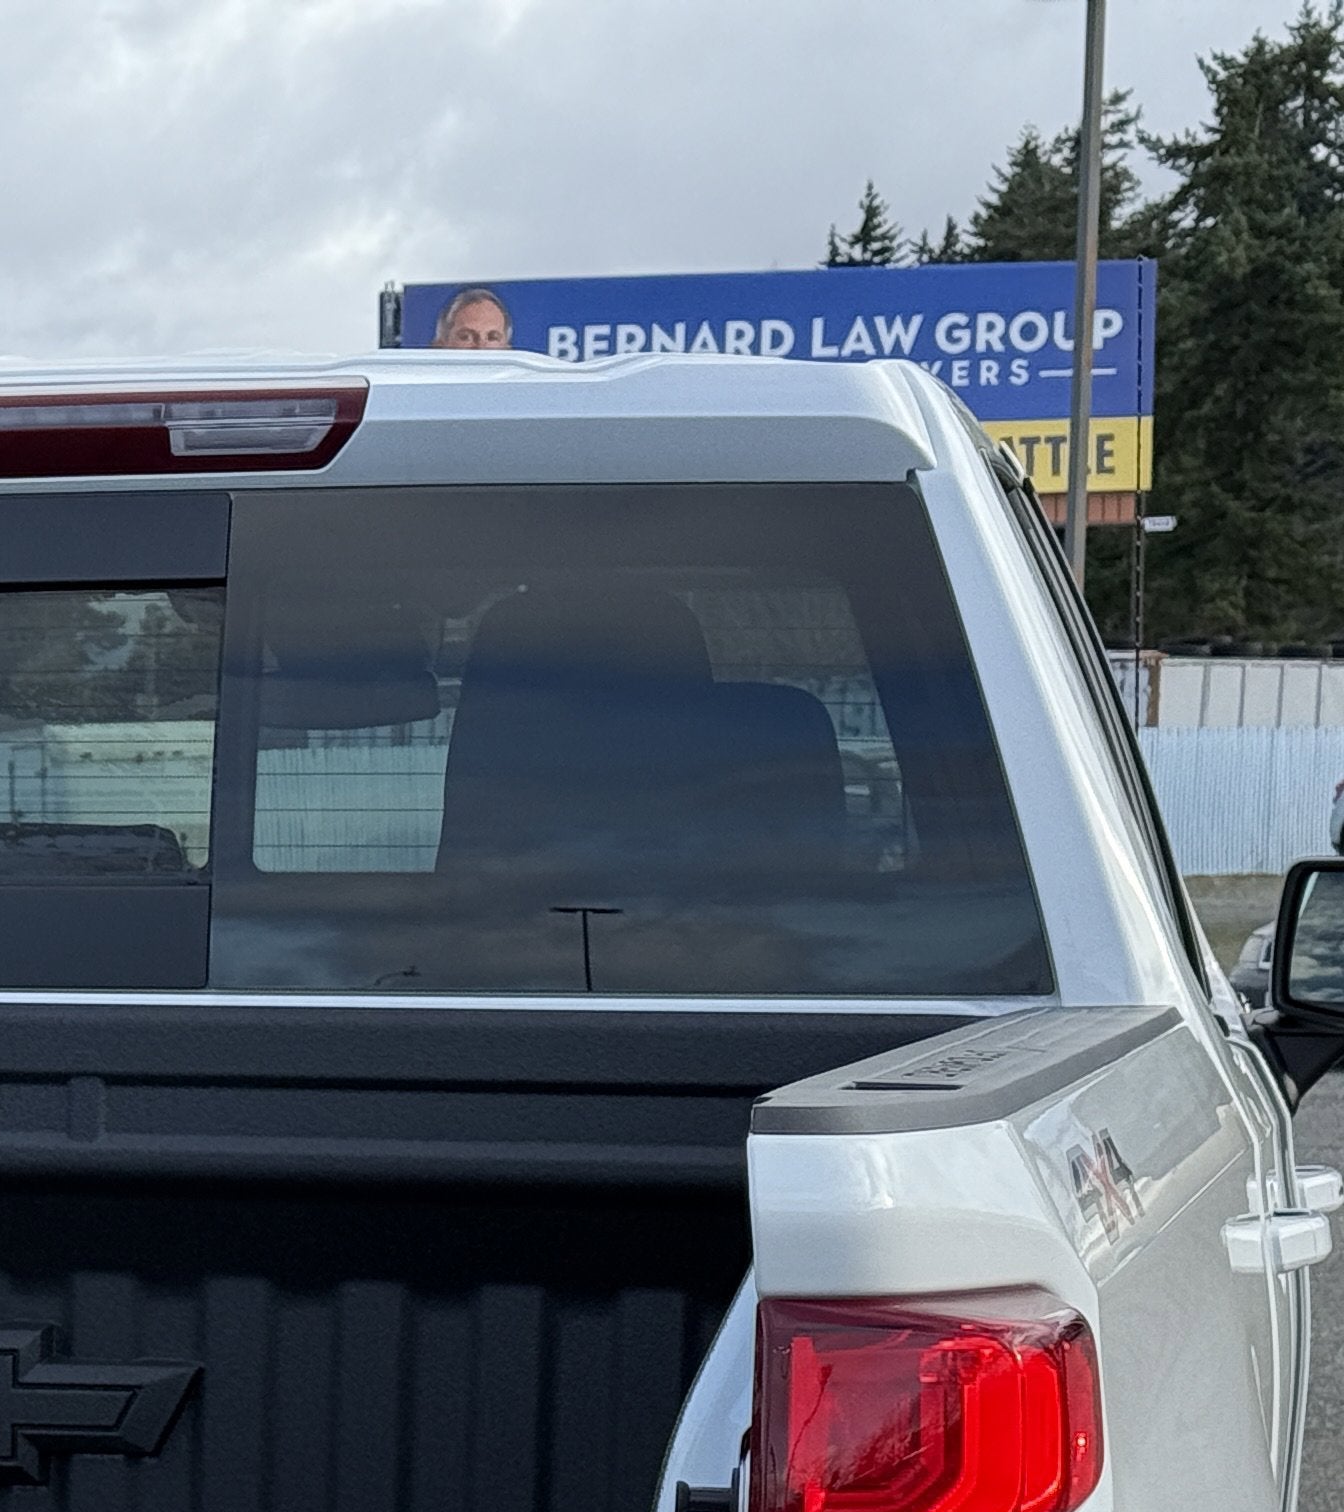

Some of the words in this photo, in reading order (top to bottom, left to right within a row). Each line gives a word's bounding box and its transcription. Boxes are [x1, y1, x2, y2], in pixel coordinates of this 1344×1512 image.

[547, 319, 795, 362] BERNARD
[811, 315, 924, 358] LAW
[934, 309, 1124, 355] GROUP
